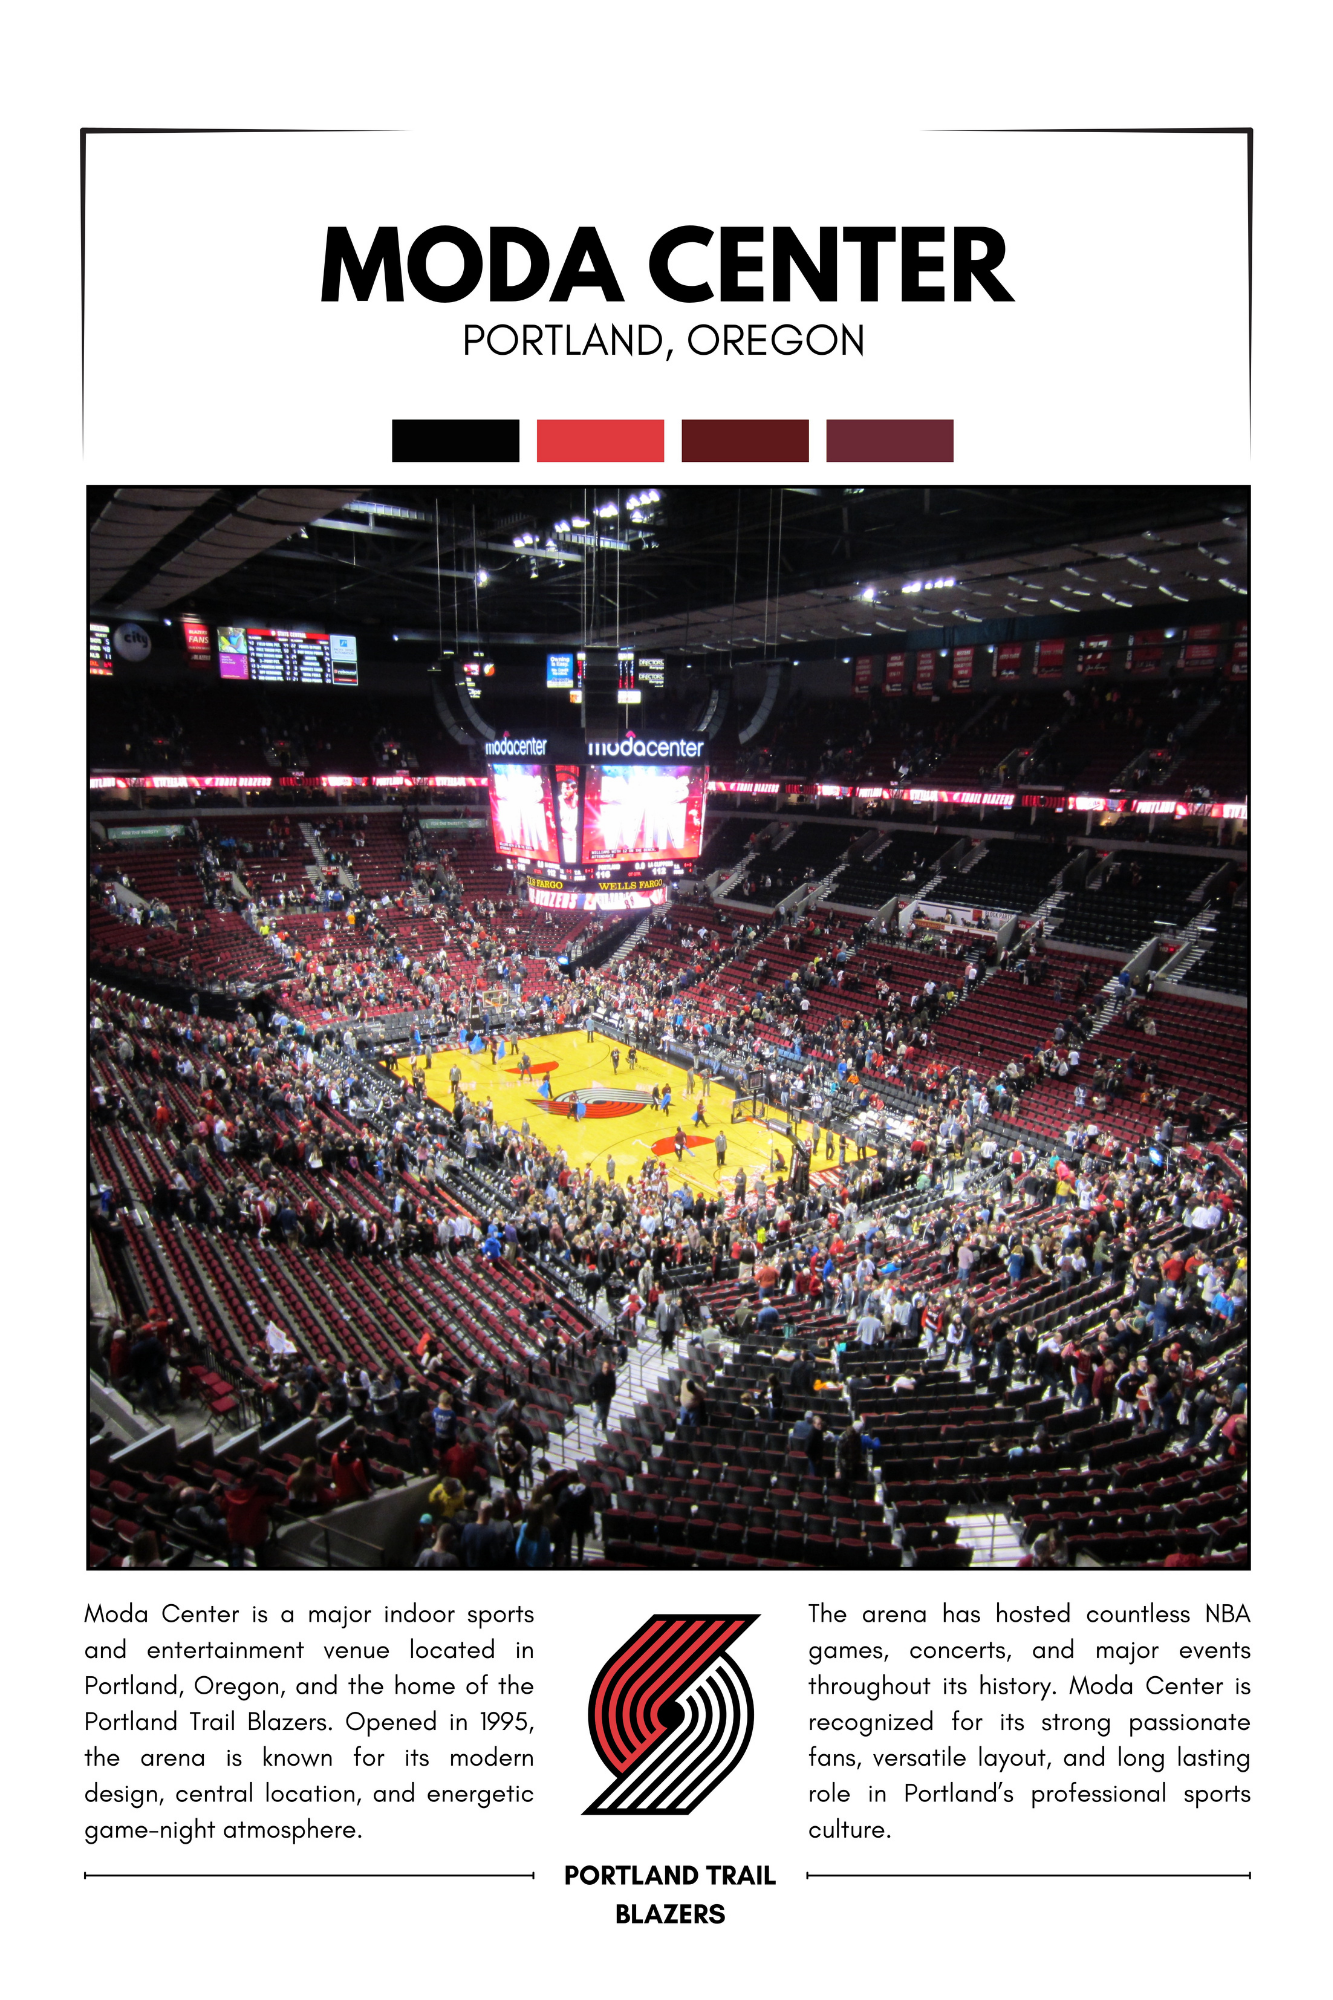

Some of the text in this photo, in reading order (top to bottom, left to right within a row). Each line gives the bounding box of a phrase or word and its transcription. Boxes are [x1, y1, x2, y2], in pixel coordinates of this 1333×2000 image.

[124, 631, 148, 648] city
[188, 635, 209, 644] FANS
[485, 737, 548, 756] modacenter
[588, 736, 704, 757] modacenter
[982, 793, 1015, 805] BLAZERS
[1135, 801, 1177, 814] PORTLAND
[652, 867, 667, 875] 112
[536, 879, 563, 889] FARGO
[599, 879, 663, 891] WELLS FARGO
